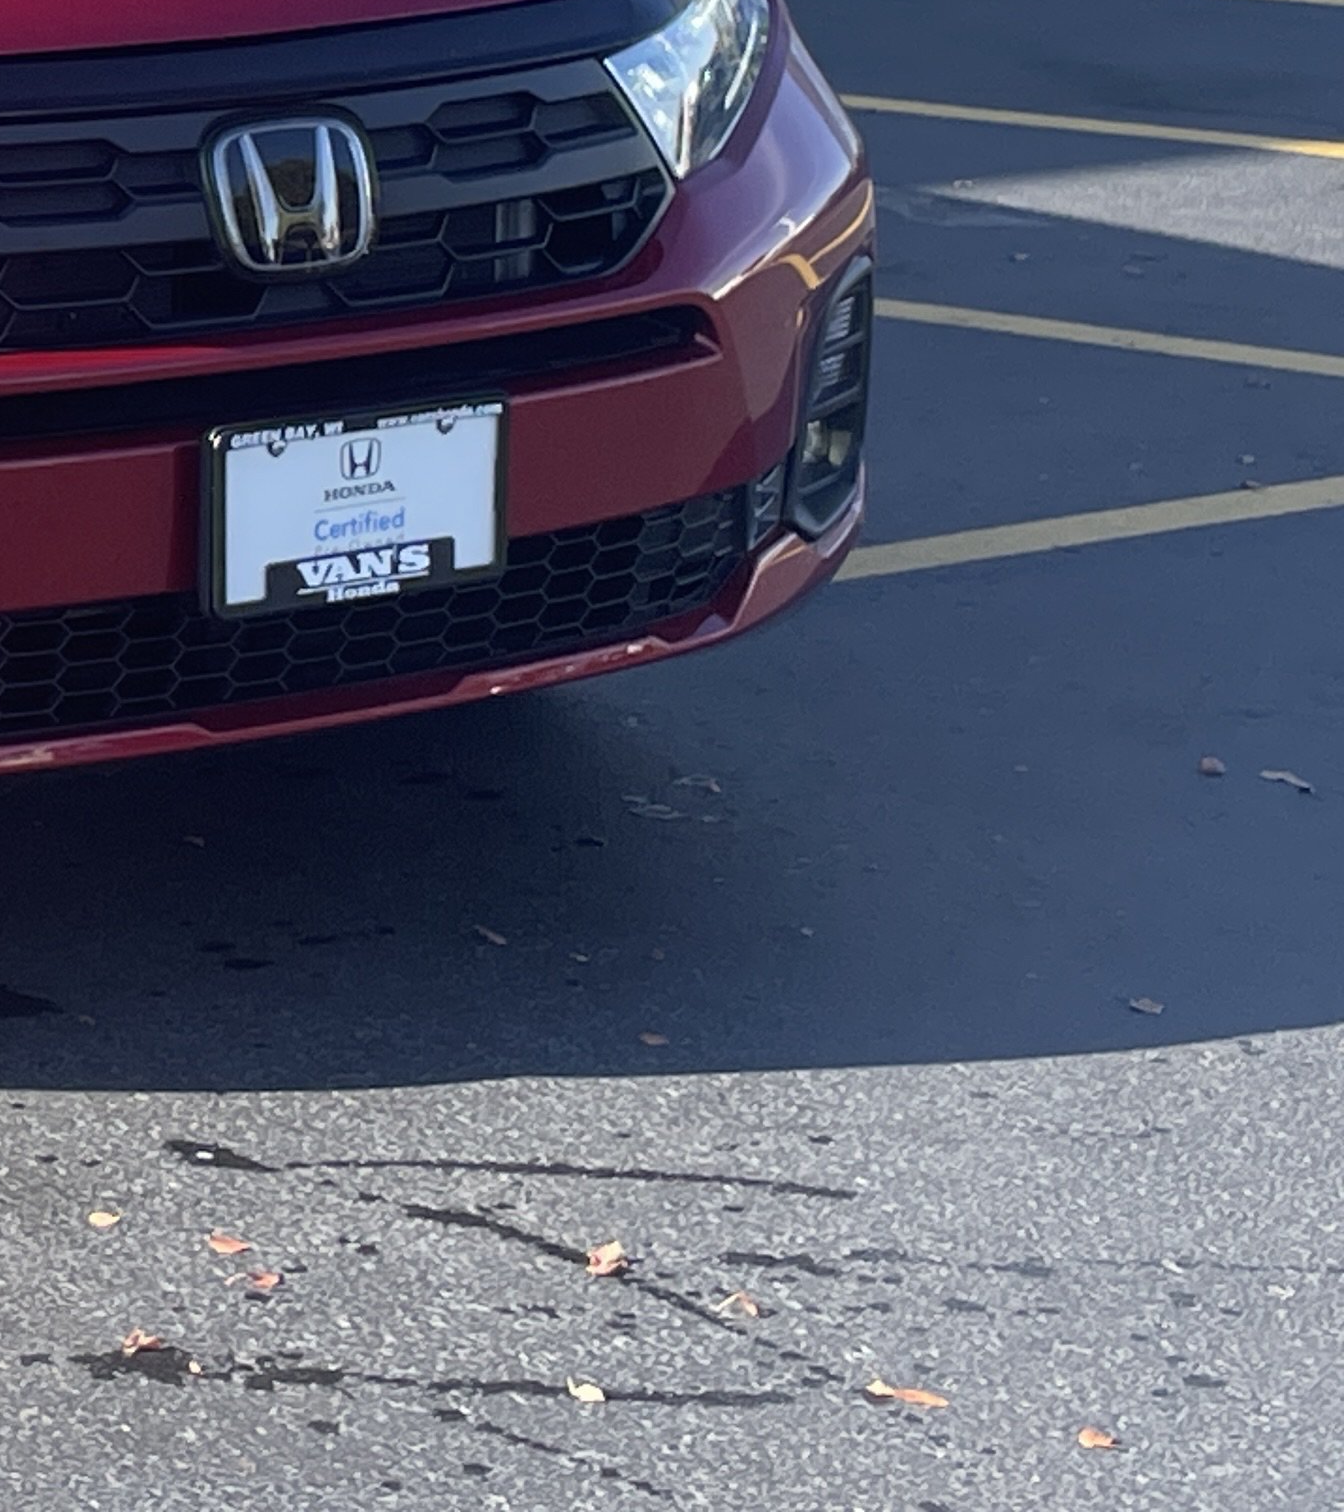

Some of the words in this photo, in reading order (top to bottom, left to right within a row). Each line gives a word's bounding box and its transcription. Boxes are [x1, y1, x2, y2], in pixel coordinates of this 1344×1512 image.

[324, 480, 396, 502] HONDA
[314, 506, 406, 541] Certified
[326, 580, 400, 603] Honda
